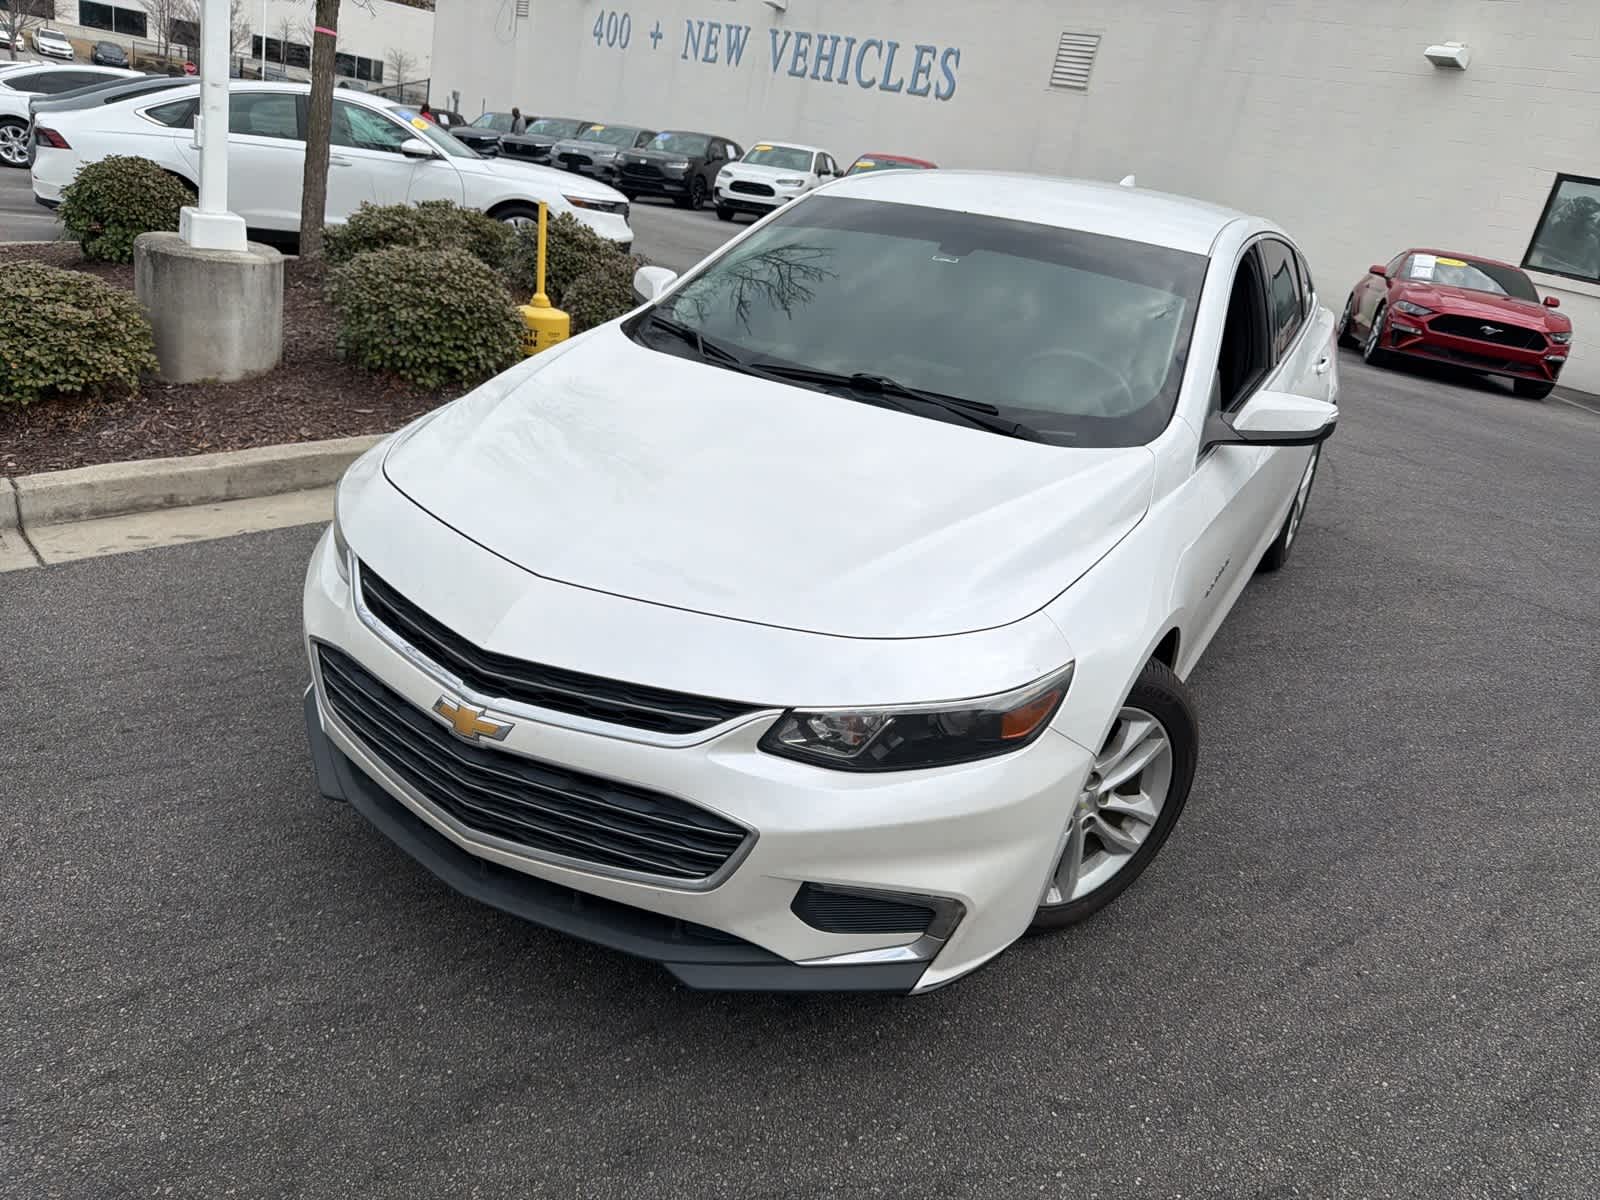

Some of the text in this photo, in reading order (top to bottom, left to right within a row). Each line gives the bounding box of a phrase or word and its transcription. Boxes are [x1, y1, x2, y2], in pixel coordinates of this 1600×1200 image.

[592, 9, 961, 101] 400 + NEW VEHICLES
